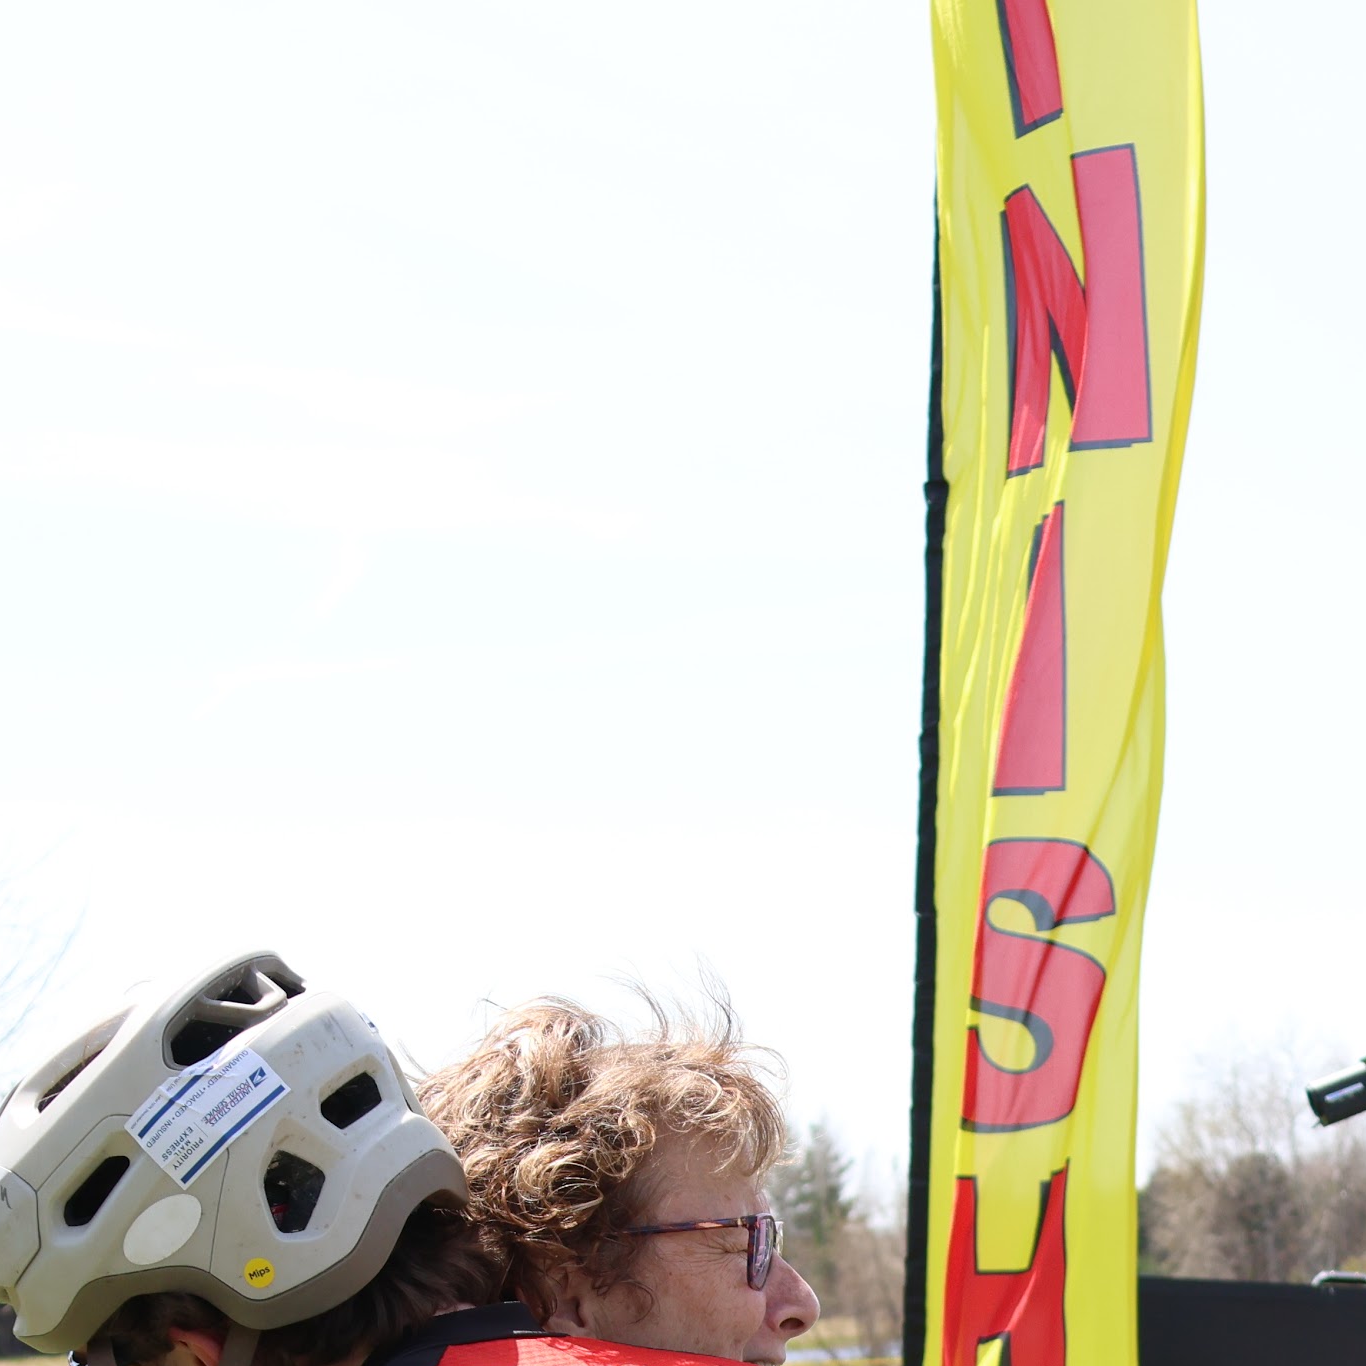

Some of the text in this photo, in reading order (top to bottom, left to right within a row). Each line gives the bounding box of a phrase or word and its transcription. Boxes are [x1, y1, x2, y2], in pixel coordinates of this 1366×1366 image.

[175, 1088, 205, 1118] TRACKED
[208, 1084, 253, 1126] UNITED STATES
[226, 1079, 250, 1102] POSTAL
[145, 1119, 173, 1149] INSURED
[174, 1140, 191, 1158] MAIL
[172, 1137, 204, 1170] PRIORITY
[248, 1266, 271, 1281] Mips
